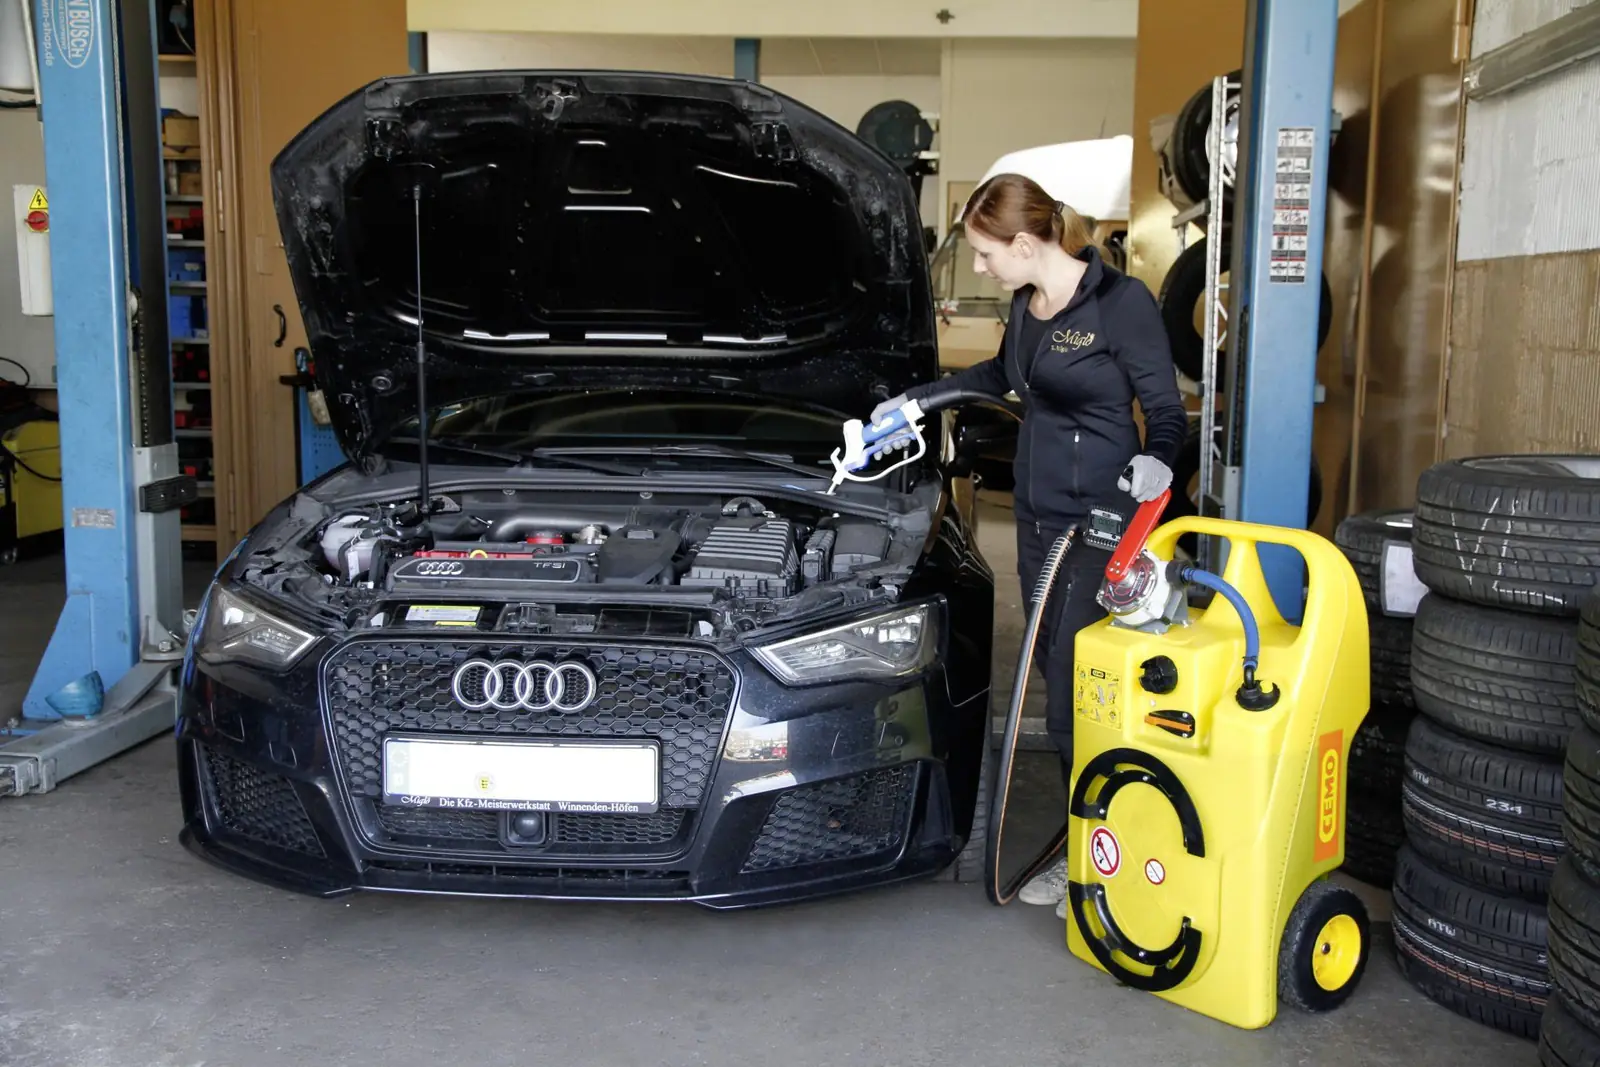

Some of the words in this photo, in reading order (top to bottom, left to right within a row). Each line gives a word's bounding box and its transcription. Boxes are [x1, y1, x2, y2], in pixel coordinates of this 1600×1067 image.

[69, 10, 90, 58] BUSCH
[440, 797, 455, 807] Die
[457, 798, 550, 810] Kfz-Meisterwerkstatt
[558, 801, 639, 812] Winnenden-Höfen
[1324, 756, 1335, 834] CEMO
